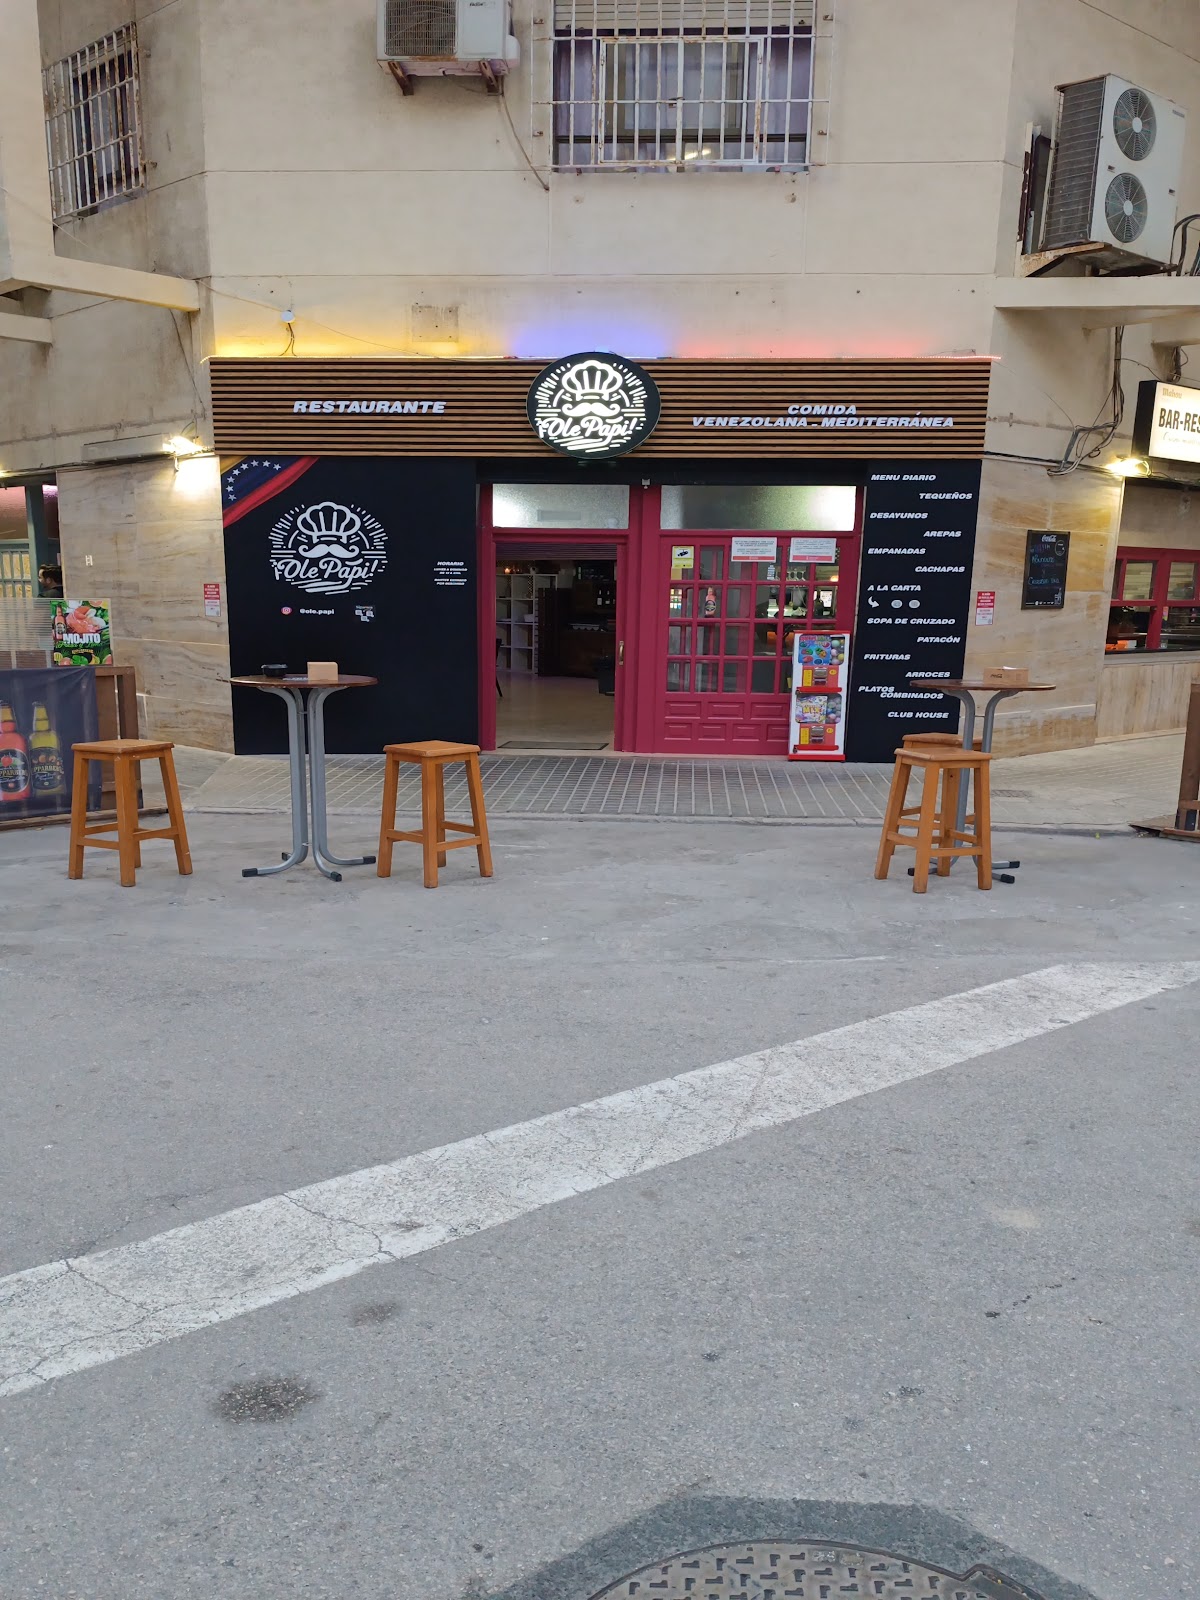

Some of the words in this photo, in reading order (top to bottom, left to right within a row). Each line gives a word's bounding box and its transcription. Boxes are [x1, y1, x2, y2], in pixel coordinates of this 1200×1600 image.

[293, 400, 447, 414] RESTAURANTE
[787, 404, 857, 415] COMIDA
[692, 416, 808, 428] VENEZOLANA
[821, 411, 954, 428] MEDITERRÁNEA
[919, 491, 973, 500] TEQUEÑOS
[867, 547, 926, 555] EMPANADAS
[867, 617, 893, 625] SOPA
[894, 617, 908, 625] DE
[909, 617, 956, 625] CRUZADO
[63, 633, 101, 644] MOJITO
[916, 635, 961, 643] PATACÓN
[863, 653, 911, 661] FRITURAS
[914, 711, 949, 719] HOUSE
